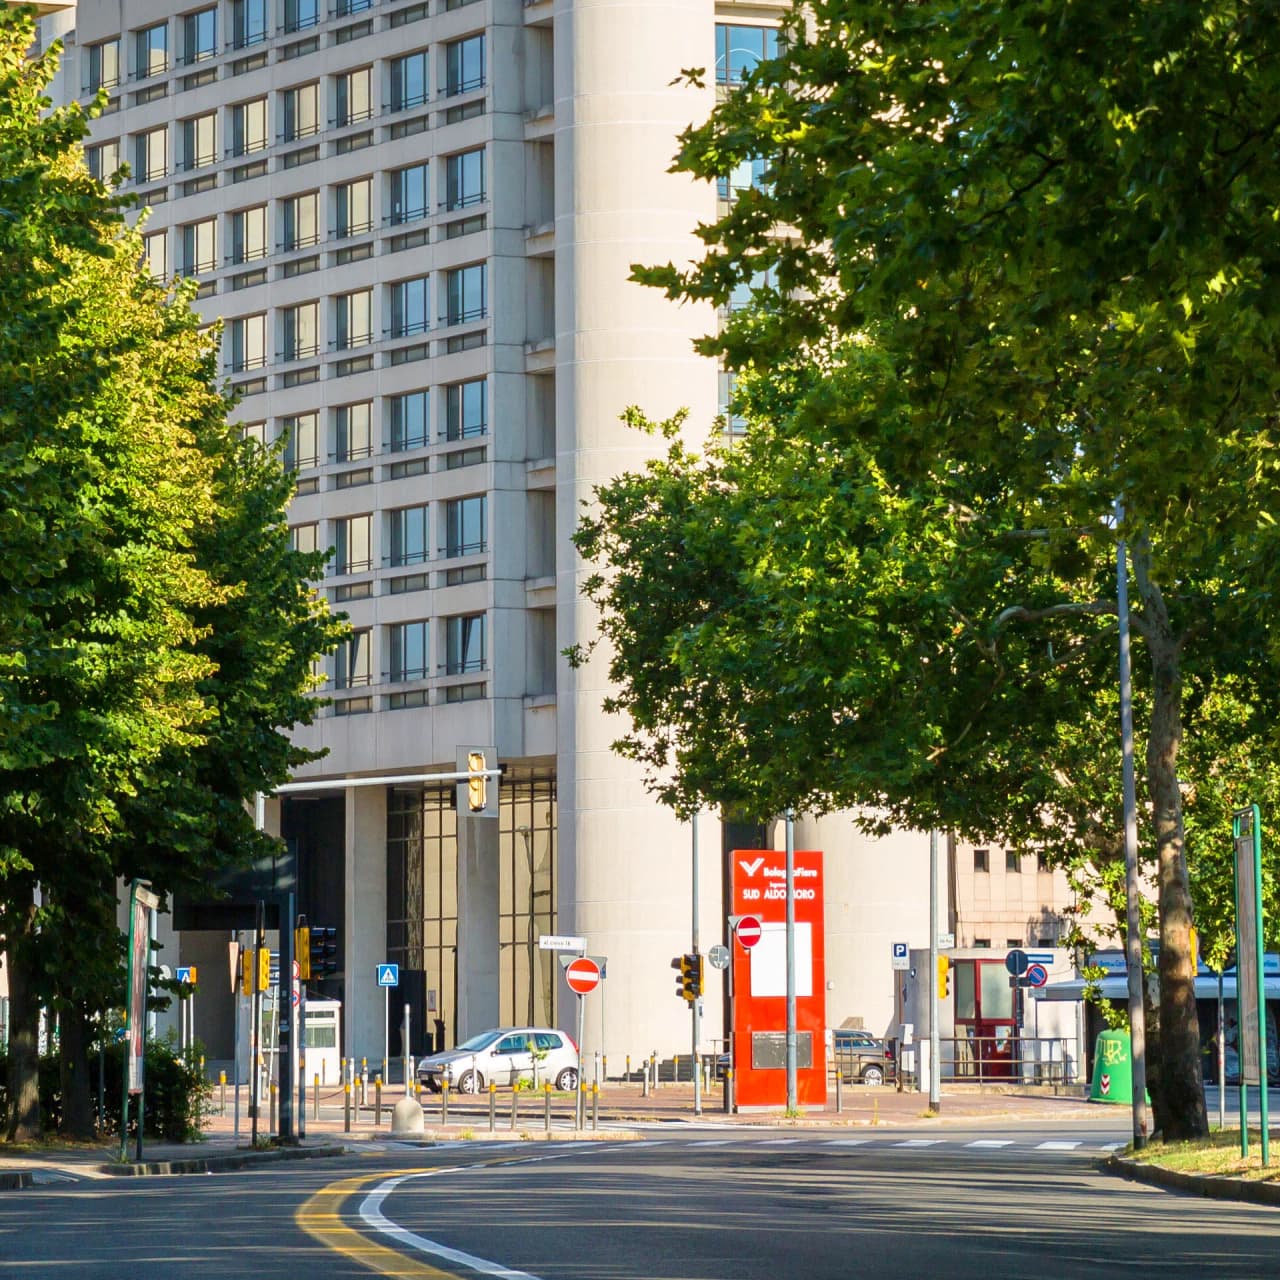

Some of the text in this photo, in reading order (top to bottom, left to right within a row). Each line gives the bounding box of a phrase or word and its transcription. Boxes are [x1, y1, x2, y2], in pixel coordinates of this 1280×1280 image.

[763, 867, 817, 879] BologaFiere
[742, 888, 761, 899] SUD
[763, 888, 786, 899] ALDO
[896, 945, 905, 956] P
